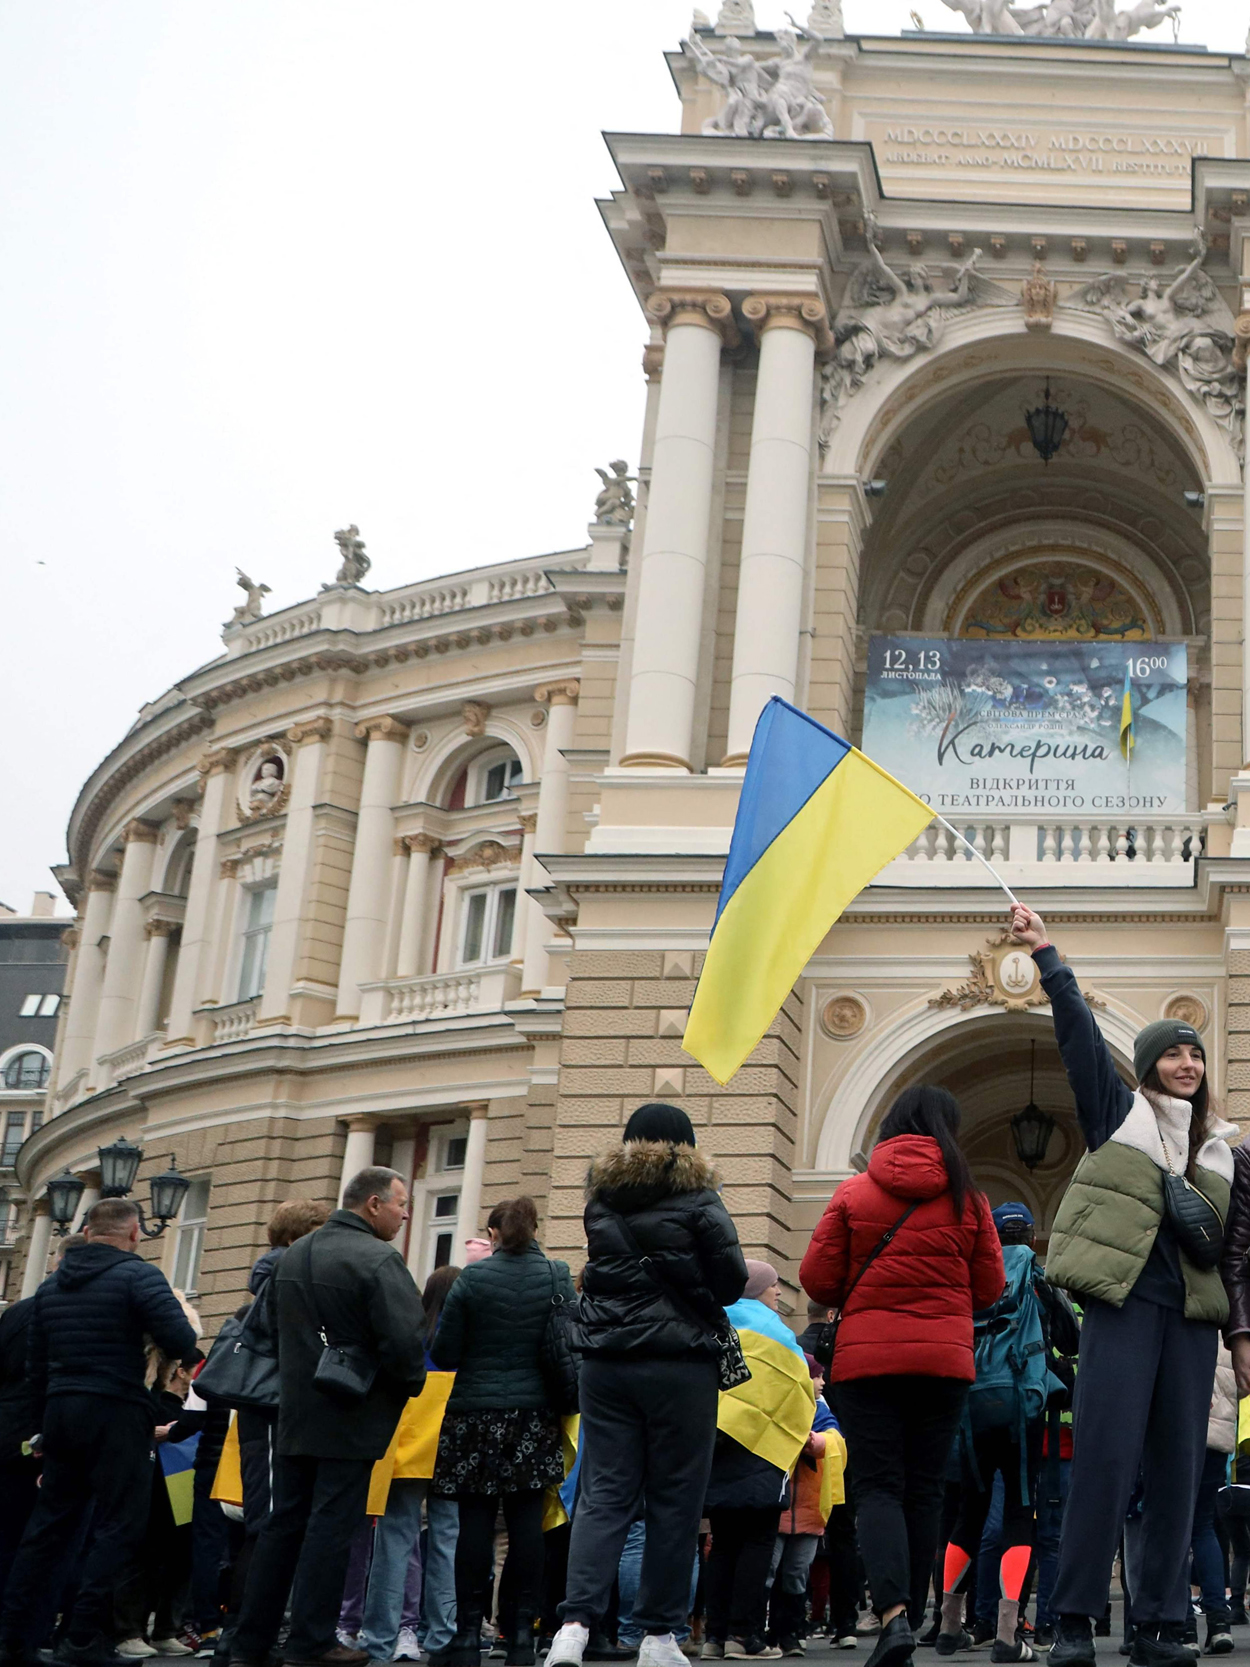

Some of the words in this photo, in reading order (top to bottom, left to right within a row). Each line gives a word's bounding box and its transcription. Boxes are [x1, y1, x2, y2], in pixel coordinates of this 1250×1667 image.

[880, 670, 942, 681] ЛИСТОПАДА
[979, 710, 1023, 718] СВІТОВА
[937, 711, 1111, 775] Катерина
[969, 777, 1077, 792] ВІДКРИТТЯ
[938, 793, 1085, 808] ТЕАТРАЛЬНОГО
[1092, 795, 1168, 809] СЕЗОНУ
